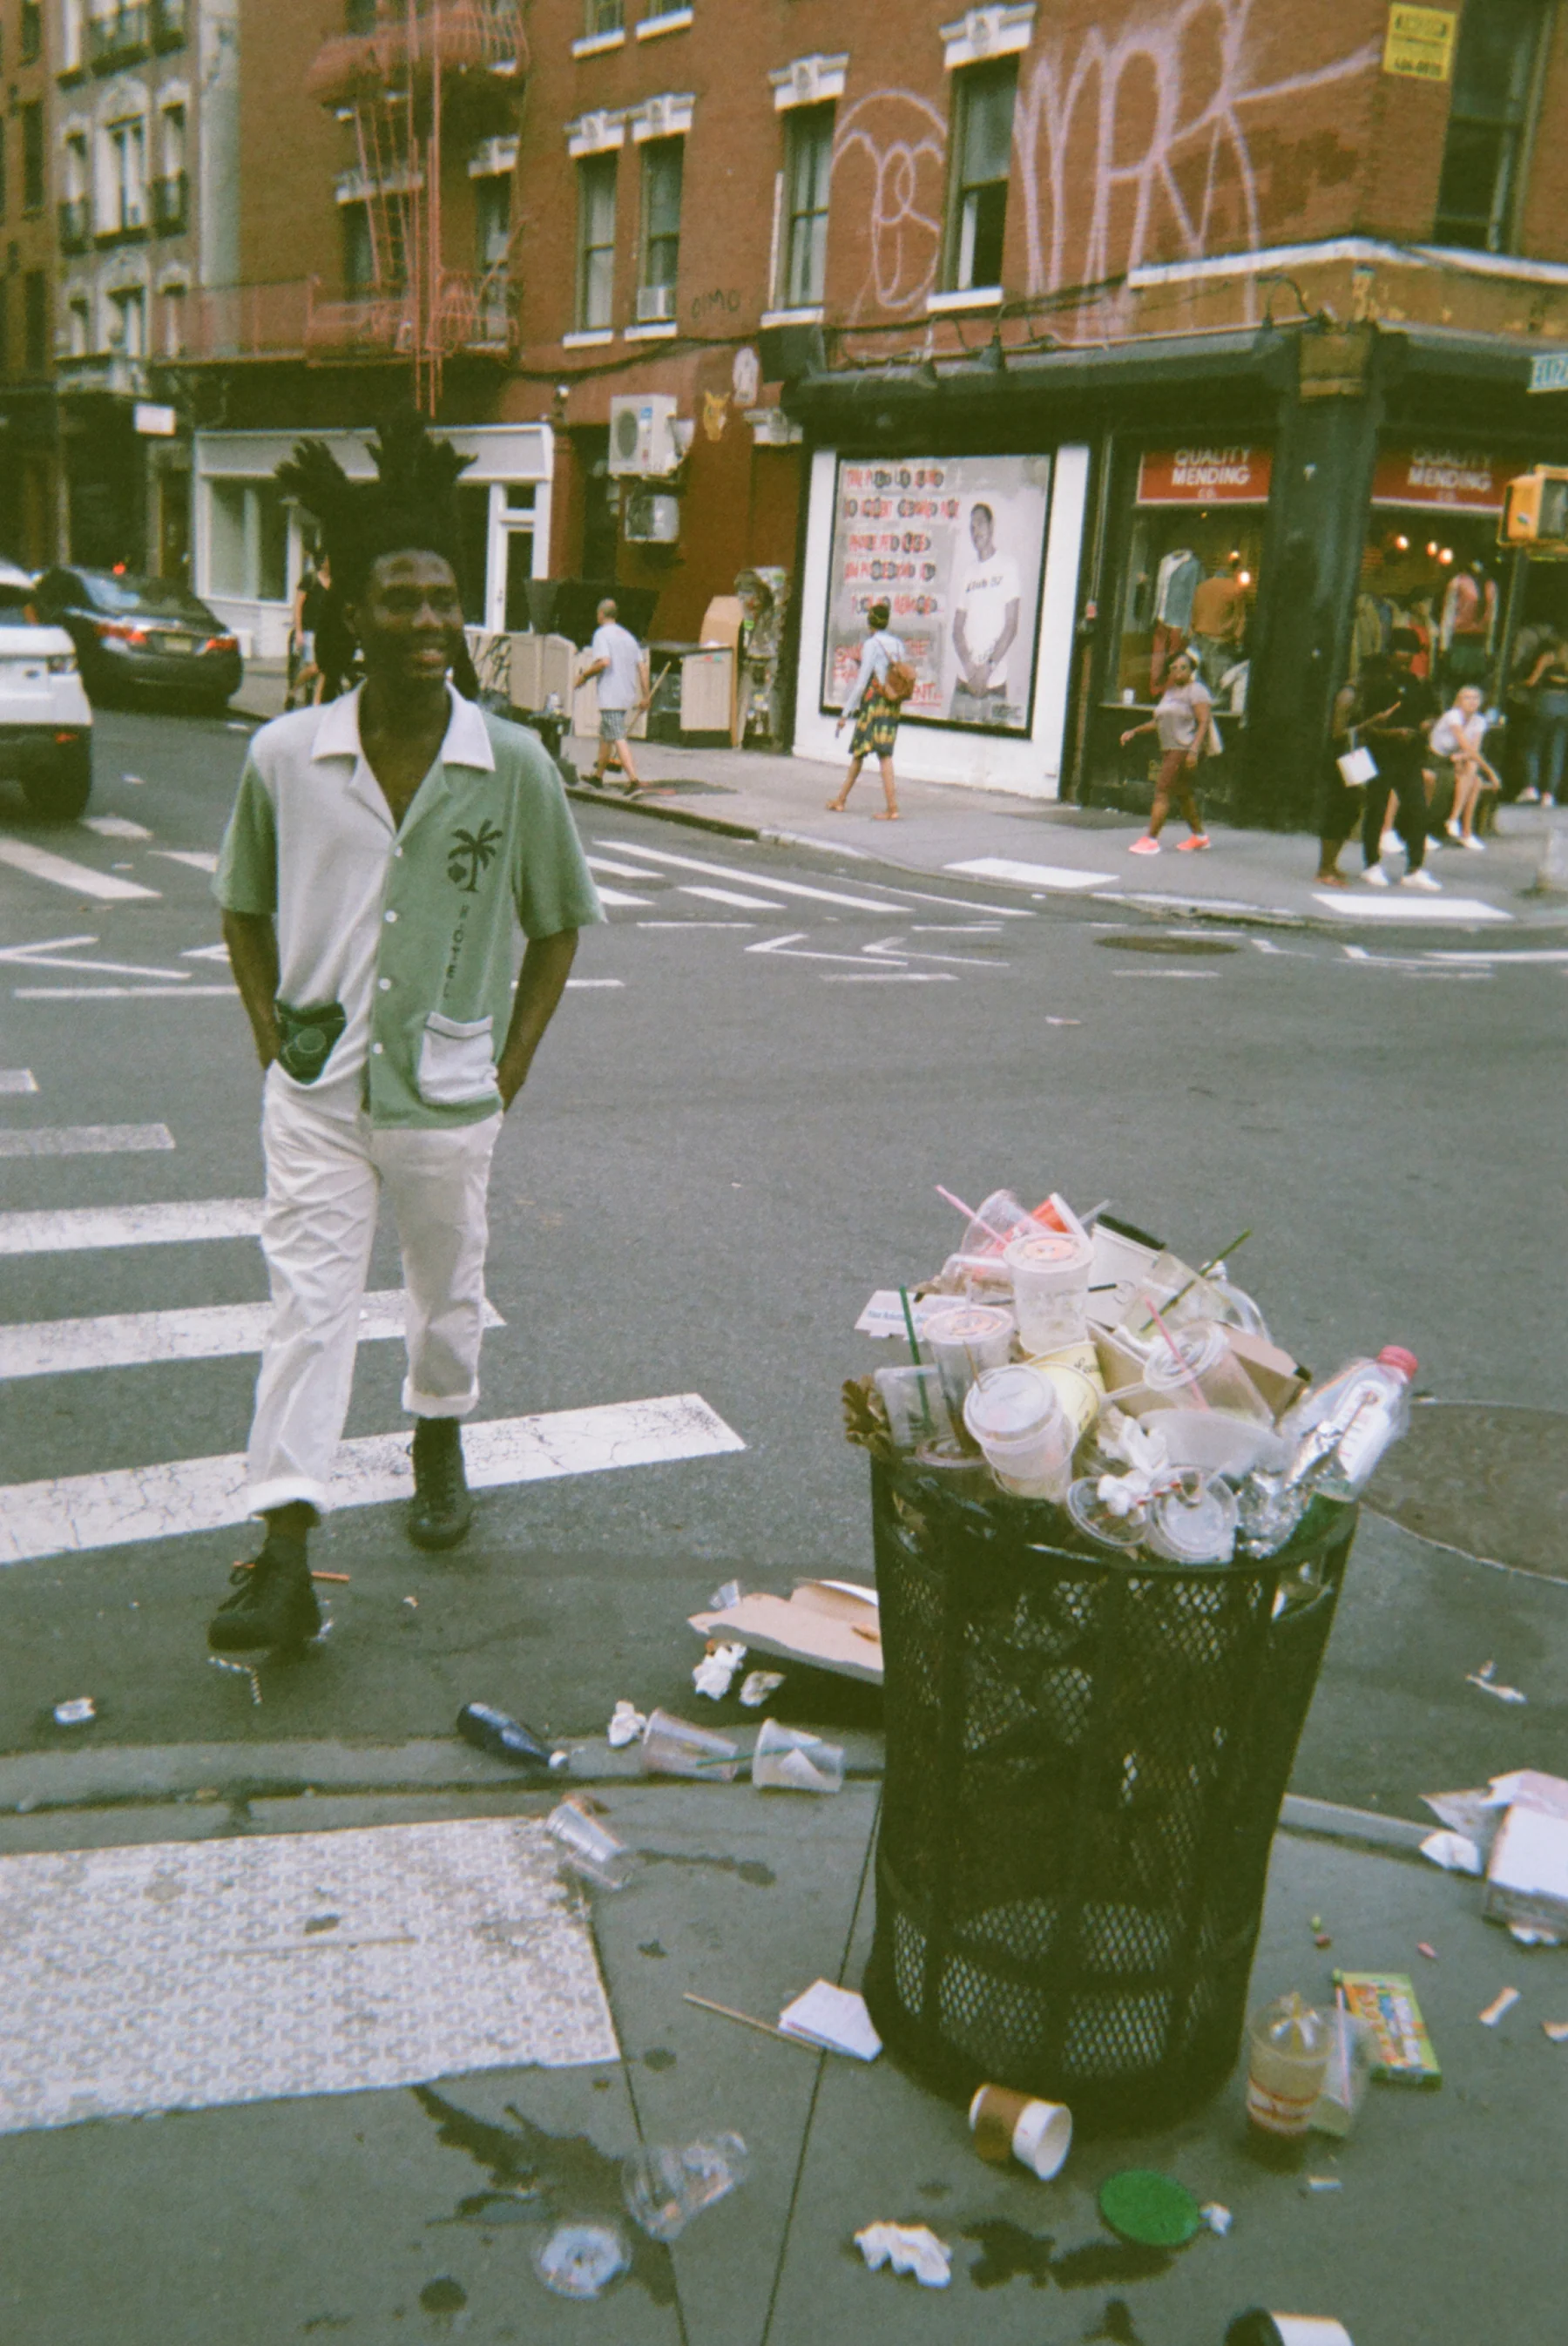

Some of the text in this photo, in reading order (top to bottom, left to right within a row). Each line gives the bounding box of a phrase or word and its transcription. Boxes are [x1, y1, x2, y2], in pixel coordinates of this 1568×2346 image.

[1532, 357, 1568, 388] ELIZ
[1174, 446, 1251, 466] QUALITY
[1171, 465, 1251, 486] MENDING
[1408, 465, 1492, 491] MENDING
